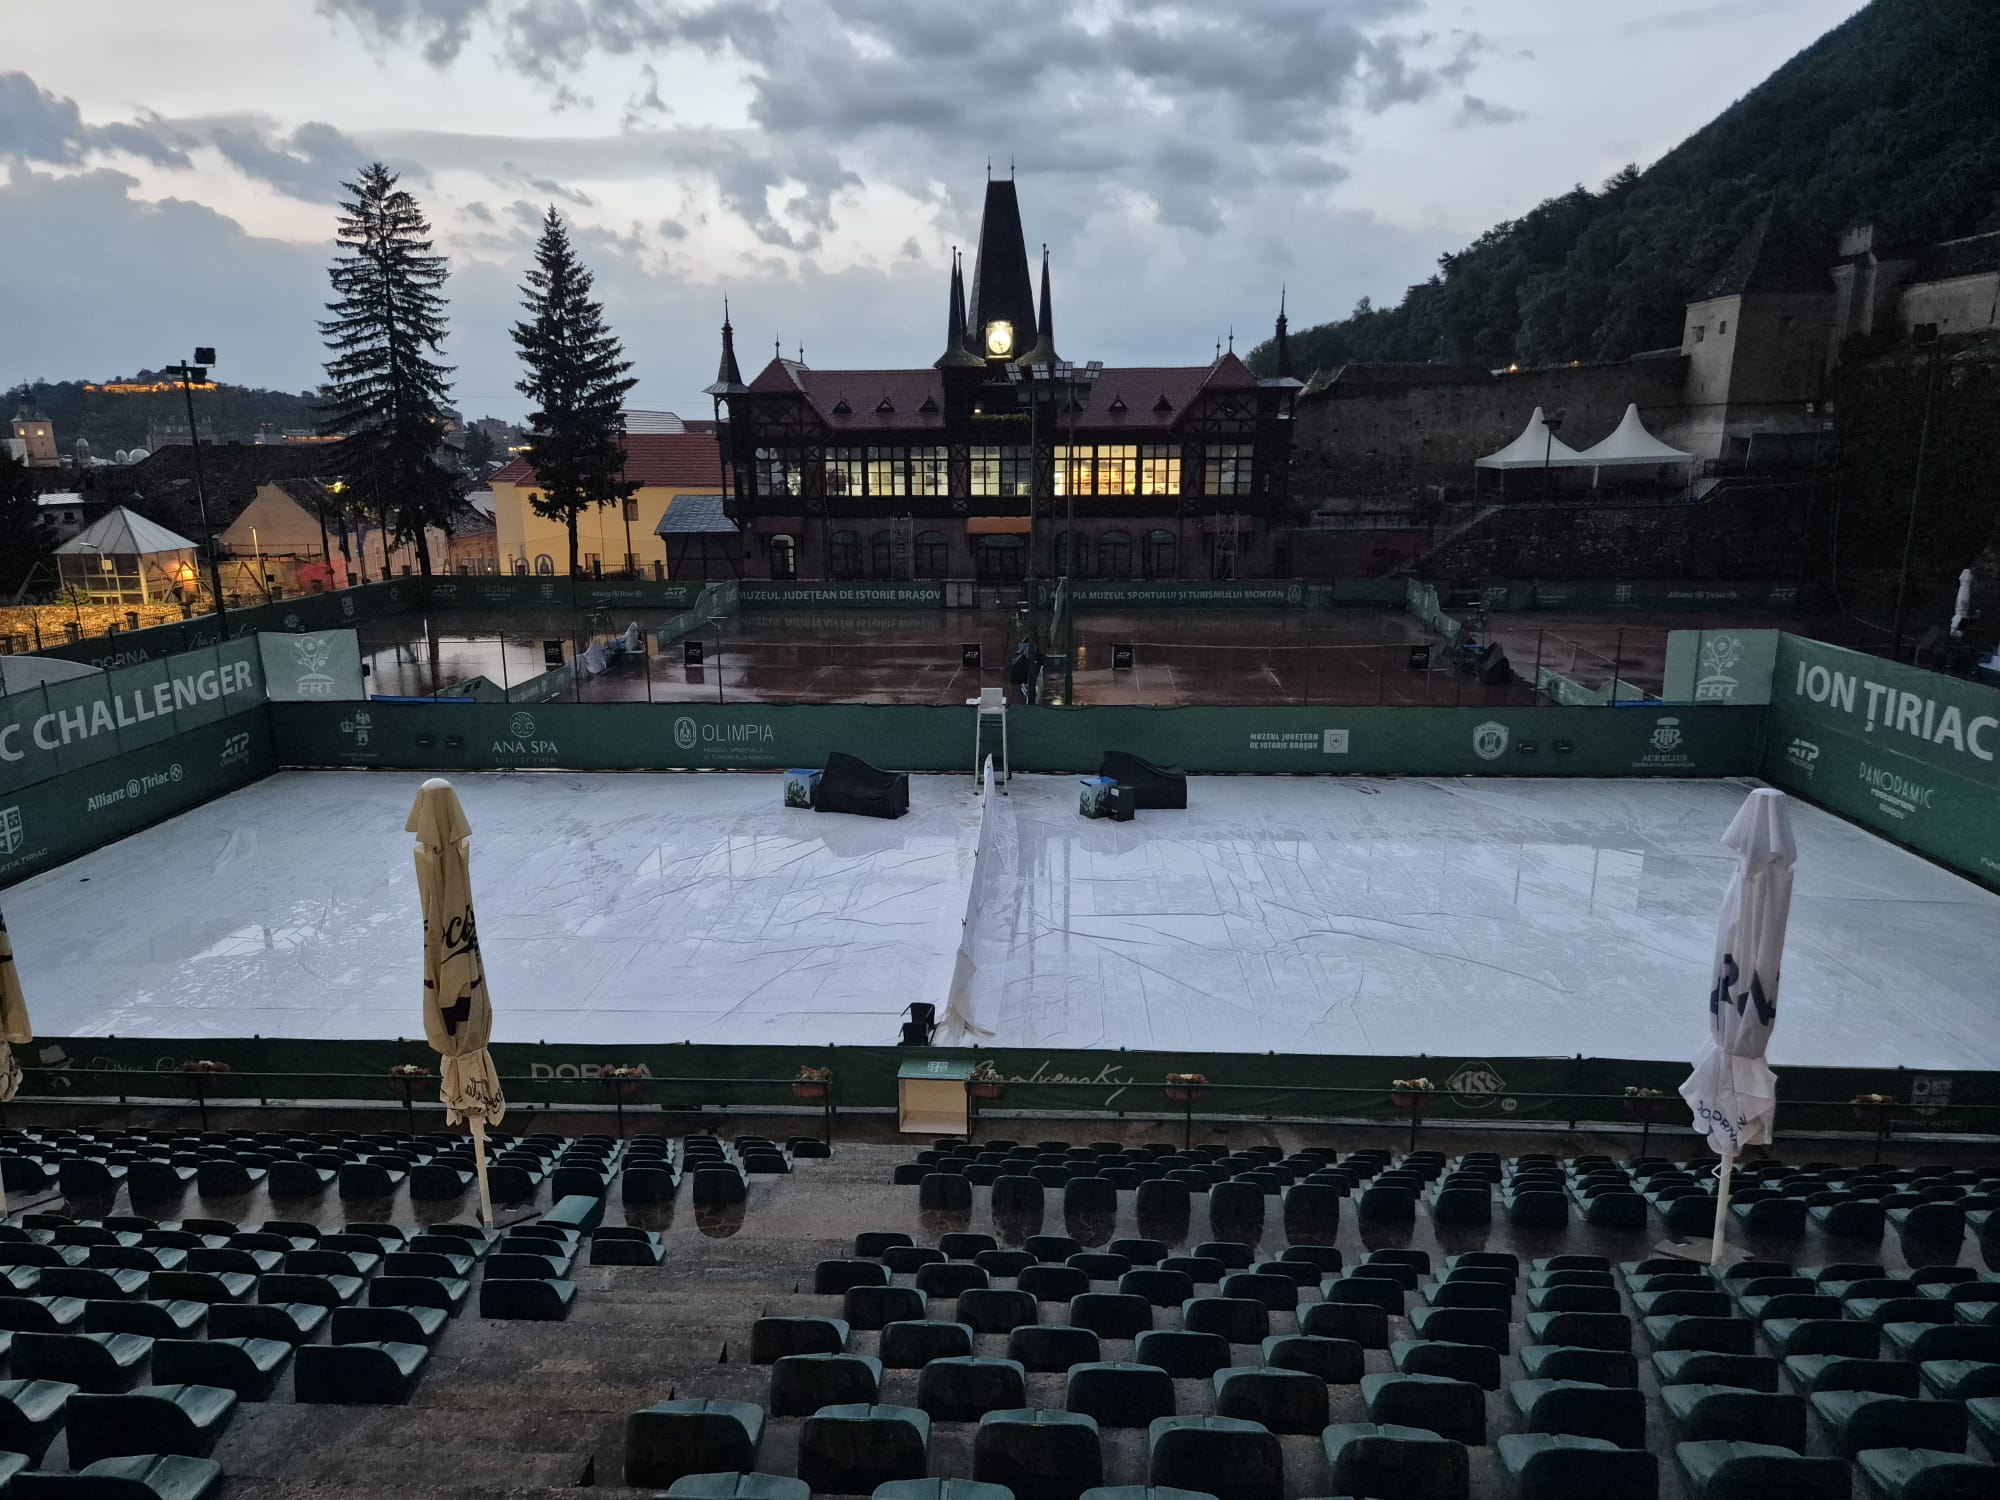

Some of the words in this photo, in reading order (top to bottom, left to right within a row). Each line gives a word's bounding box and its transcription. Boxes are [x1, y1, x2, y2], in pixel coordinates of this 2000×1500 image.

[739, 590, 781, 601] MUZEUL
[839, 589, 854, 600] DE
[856, 589, 897, 601] ISTORIE
[1089, 592, 1126, 600] MUZEUL
[1127, 591, 1177, 600] SPORTULUI
[1244, 590, 1285, 600] MONTAN
[298, 682, 335, 694] FRT
[1696, 684, 1739, 698] FRT
[1796, 660, 1857, 714] ION
[33, 660, 254, 751] CHALLENGER
[702, 724, 775, 742] OLIMPIA
[1250, 733, 1280, 741] MUZEUL
[219, 732, 250, 758] ATP
[492, 740, 525, 754] ANA
[531, 740, 559, 754] SPA
[1786, 738, 1820, 762] ATP
[87, 788, 127, 812] Allianz
[531, 1063, 653, 1084] DORA
